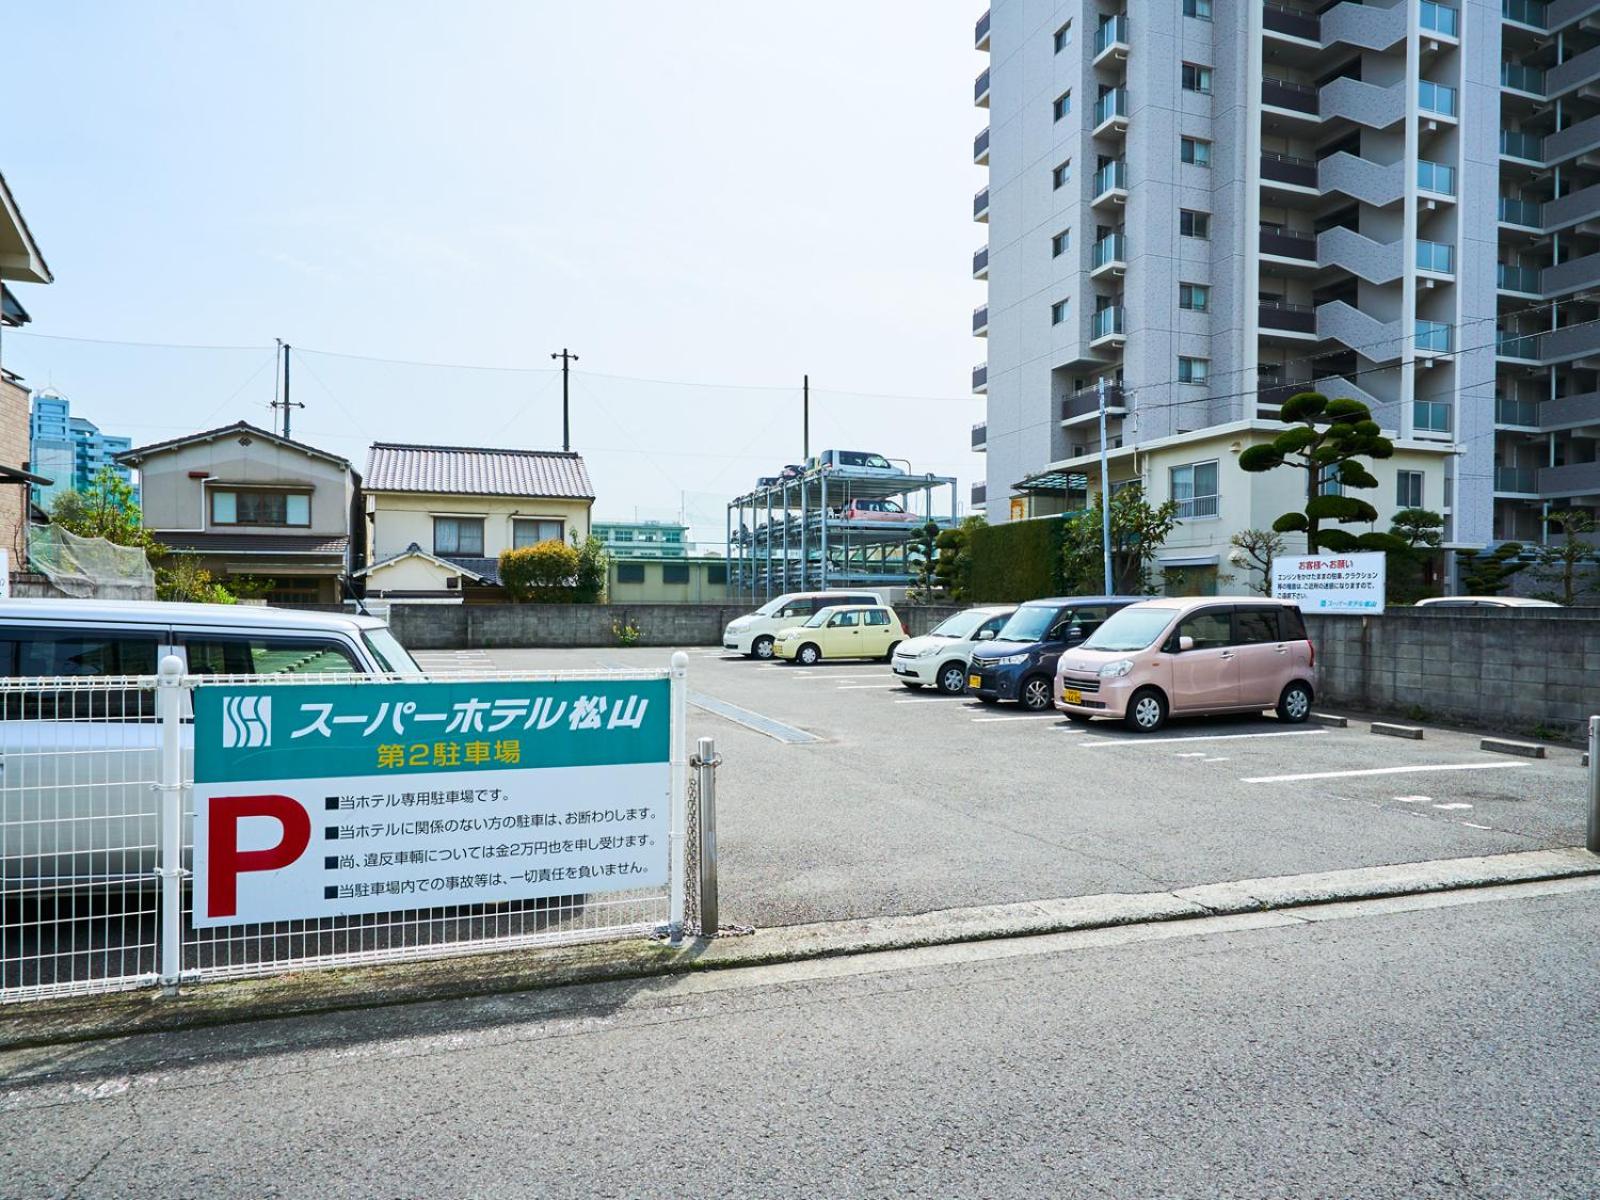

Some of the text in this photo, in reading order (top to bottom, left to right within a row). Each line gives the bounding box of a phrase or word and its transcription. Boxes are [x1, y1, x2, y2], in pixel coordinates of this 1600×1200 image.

[1298, 560, 1354, 570] お客様へお願い
[290, 694, 648, 739] スーパーホテル松山
[376, 739, 522, 769] 第2駐車場
[339, 788, 509, 810] 当ホテル専用駐車場です。
[207, 794, 311, 919] P
